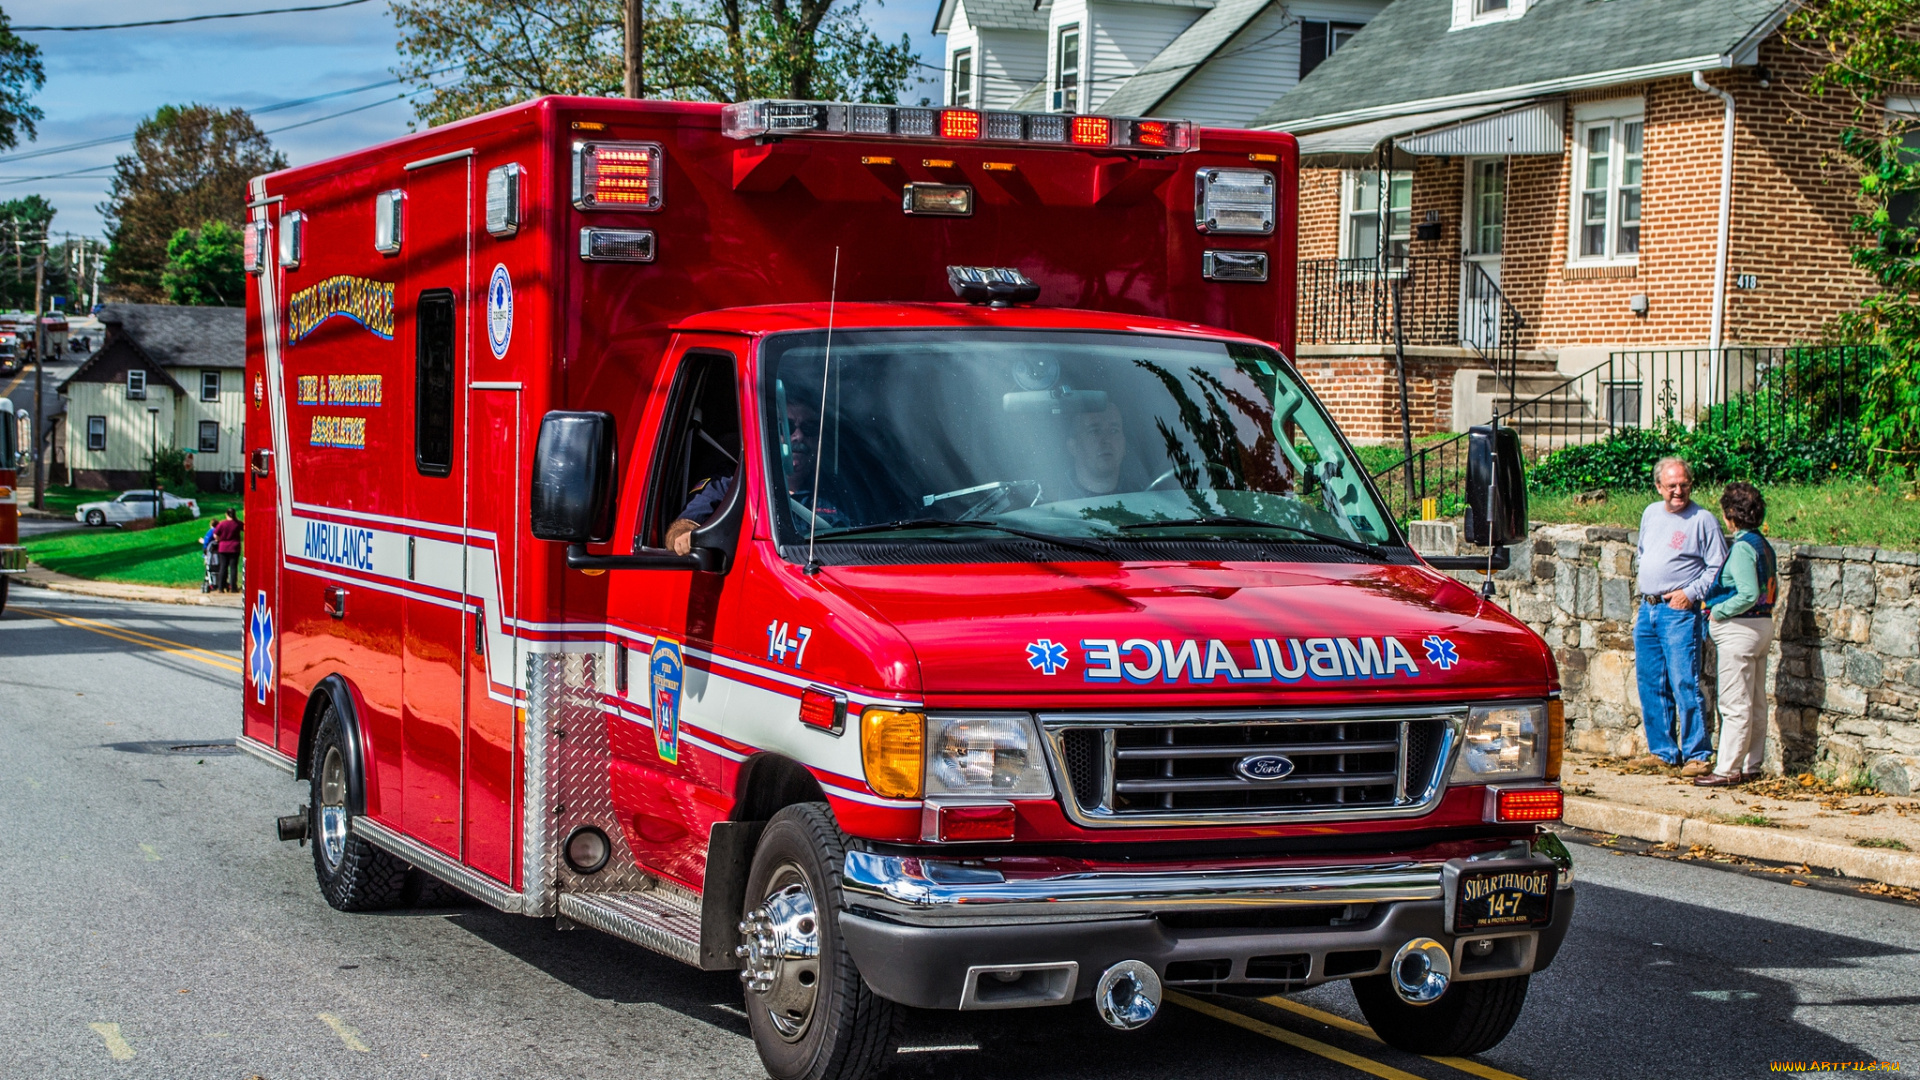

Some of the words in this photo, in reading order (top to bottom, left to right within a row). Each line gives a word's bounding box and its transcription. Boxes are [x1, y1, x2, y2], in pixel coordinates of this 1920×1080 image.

[1736, 274, 1757, 289] 418
[288, 274, 395, 346] SWARTHMORE
[297, 375, 318, 406] FIRE
[319, 374, 327, 406] &
[327, 373, 383, 407] PROTECTIVE
[310, 415, 367, 450] ASSOCIATION
[304, 520, 374, 571] AMBULANCE
[766, 618, 813, 670] 14-7
[661, 704, 670, 728] 14
[1254, 760, 1282, 774] Ford
[1464, 873, 1549, 901] SWARTHMORE
[1488, 893, 1523, 916] 14-7
